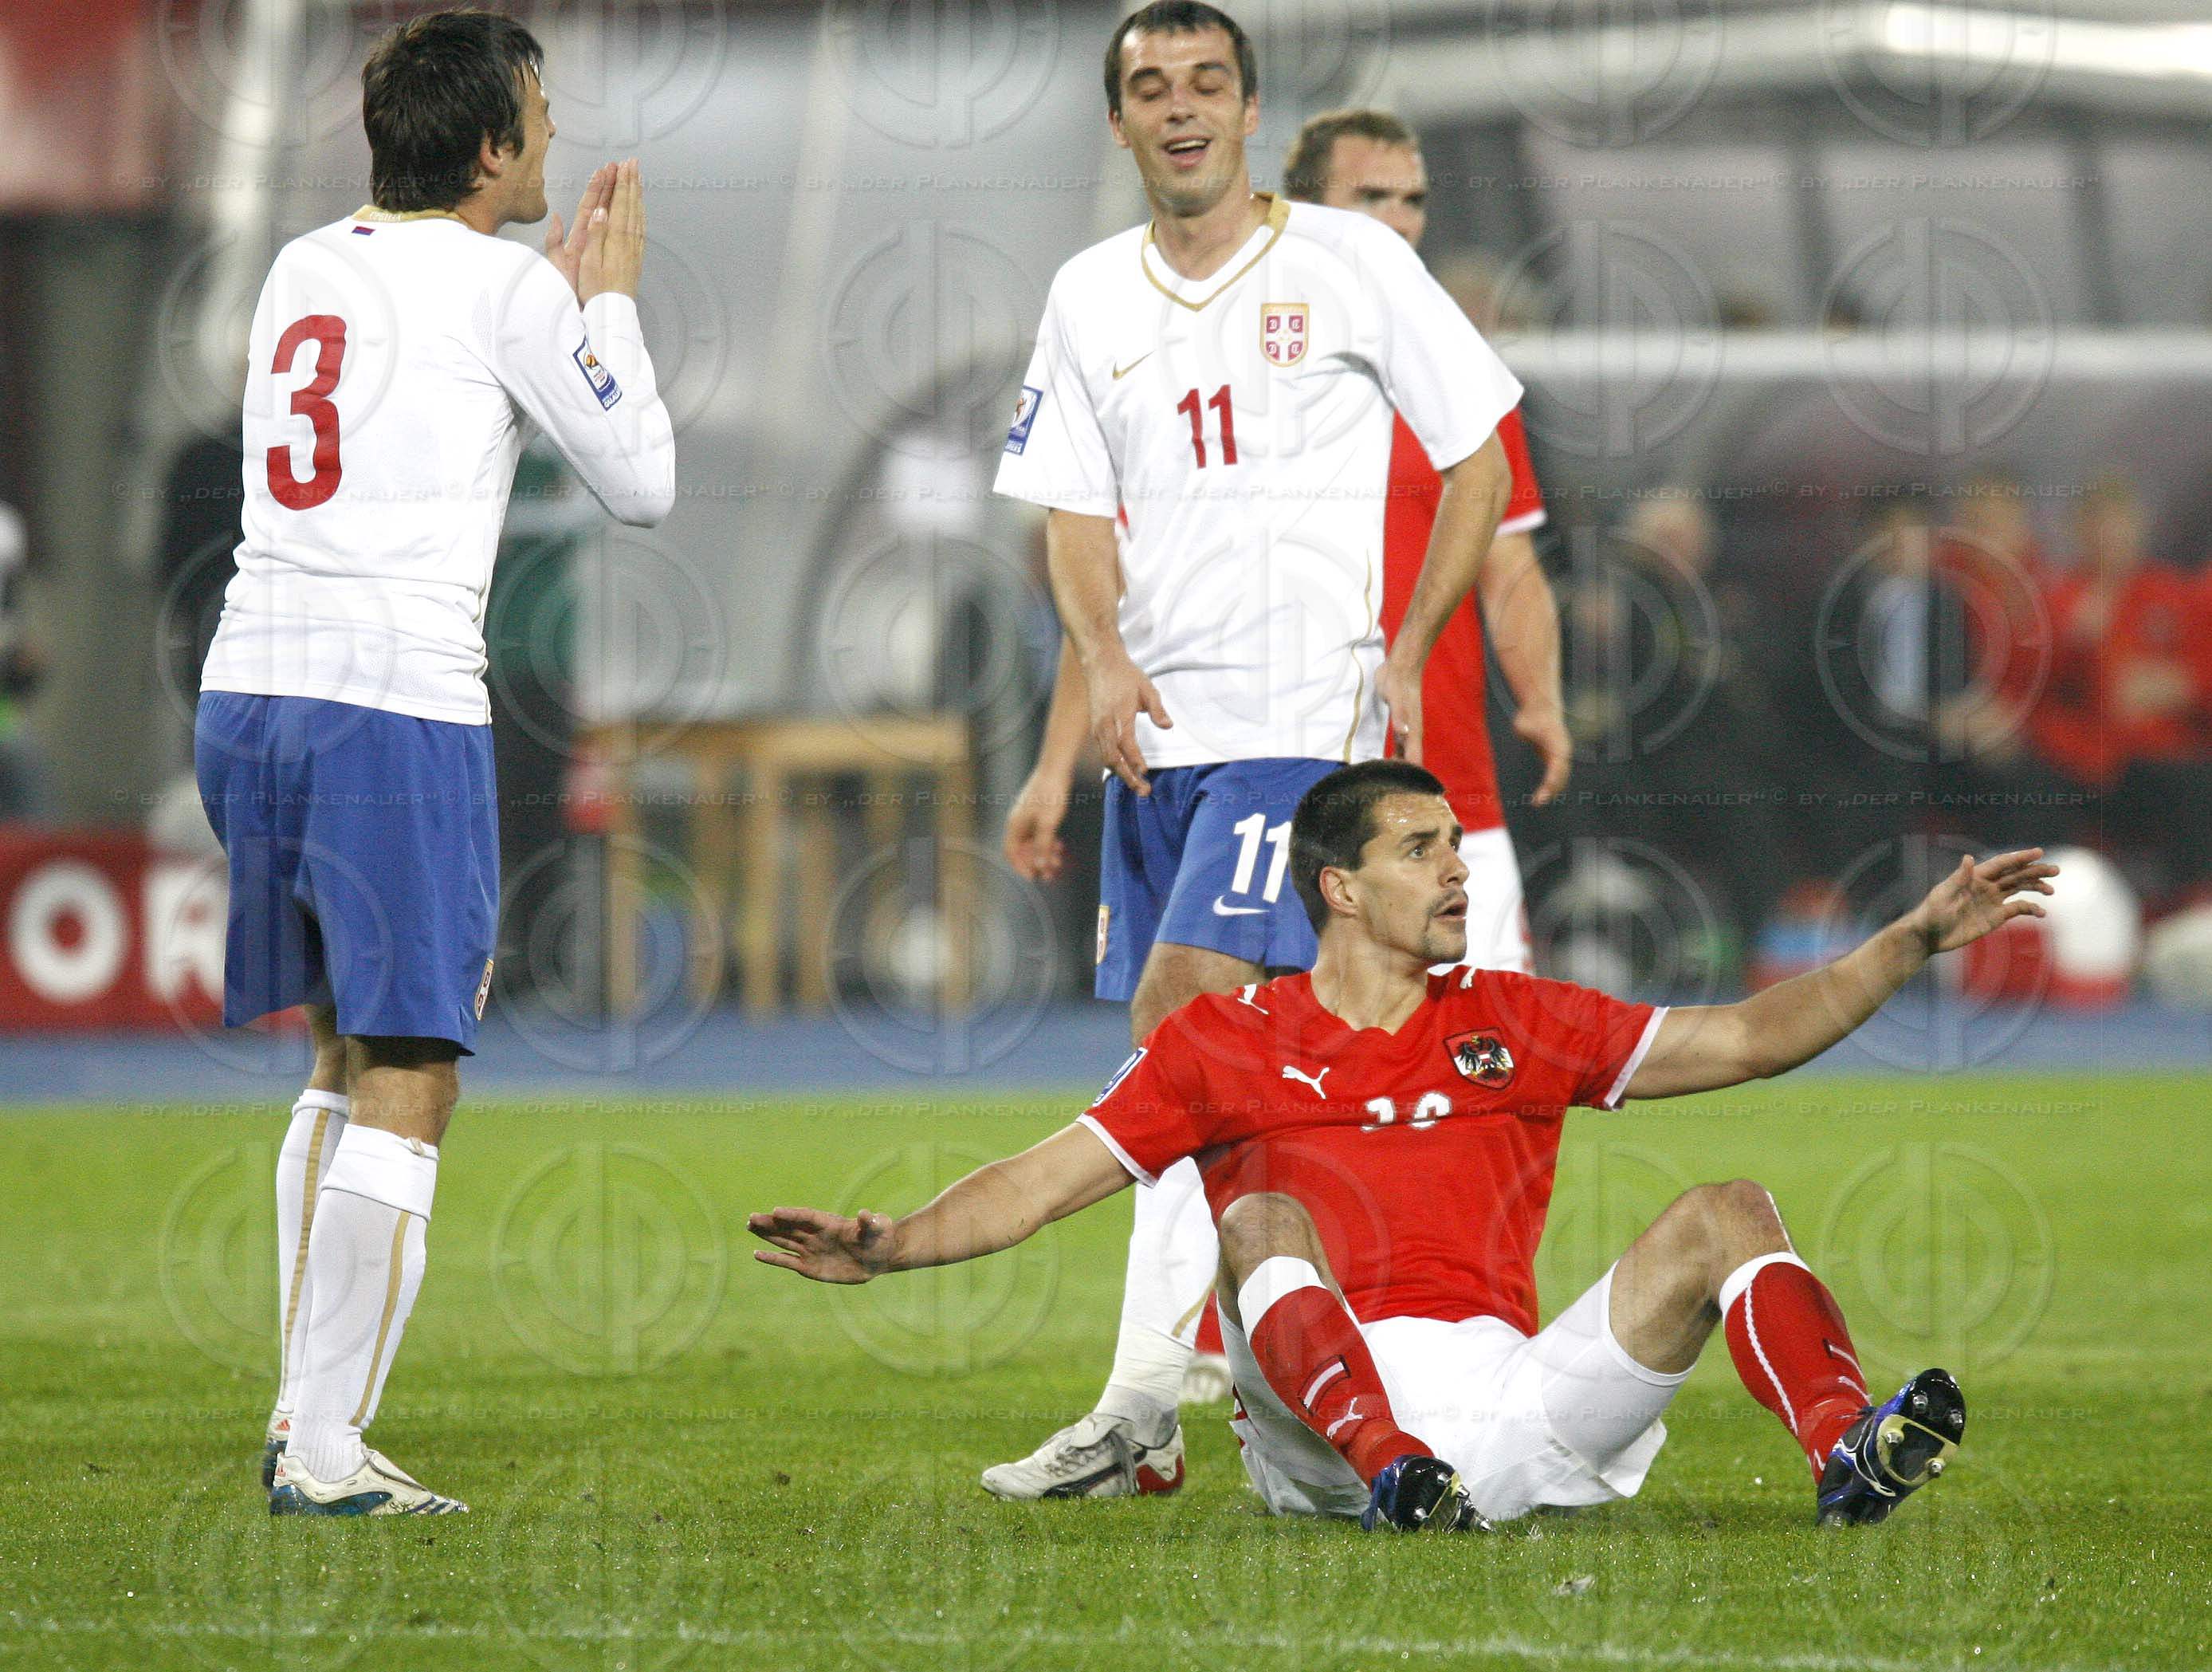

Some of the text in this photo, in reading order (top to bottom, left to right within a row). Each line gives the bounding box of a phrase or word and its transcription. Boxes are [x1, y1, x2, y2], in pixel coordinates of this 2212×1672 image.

[267, 314, 347, 510] 3
[1177, 384, 1238, 470] 11
[1231, 812, 1292, 904] 11
